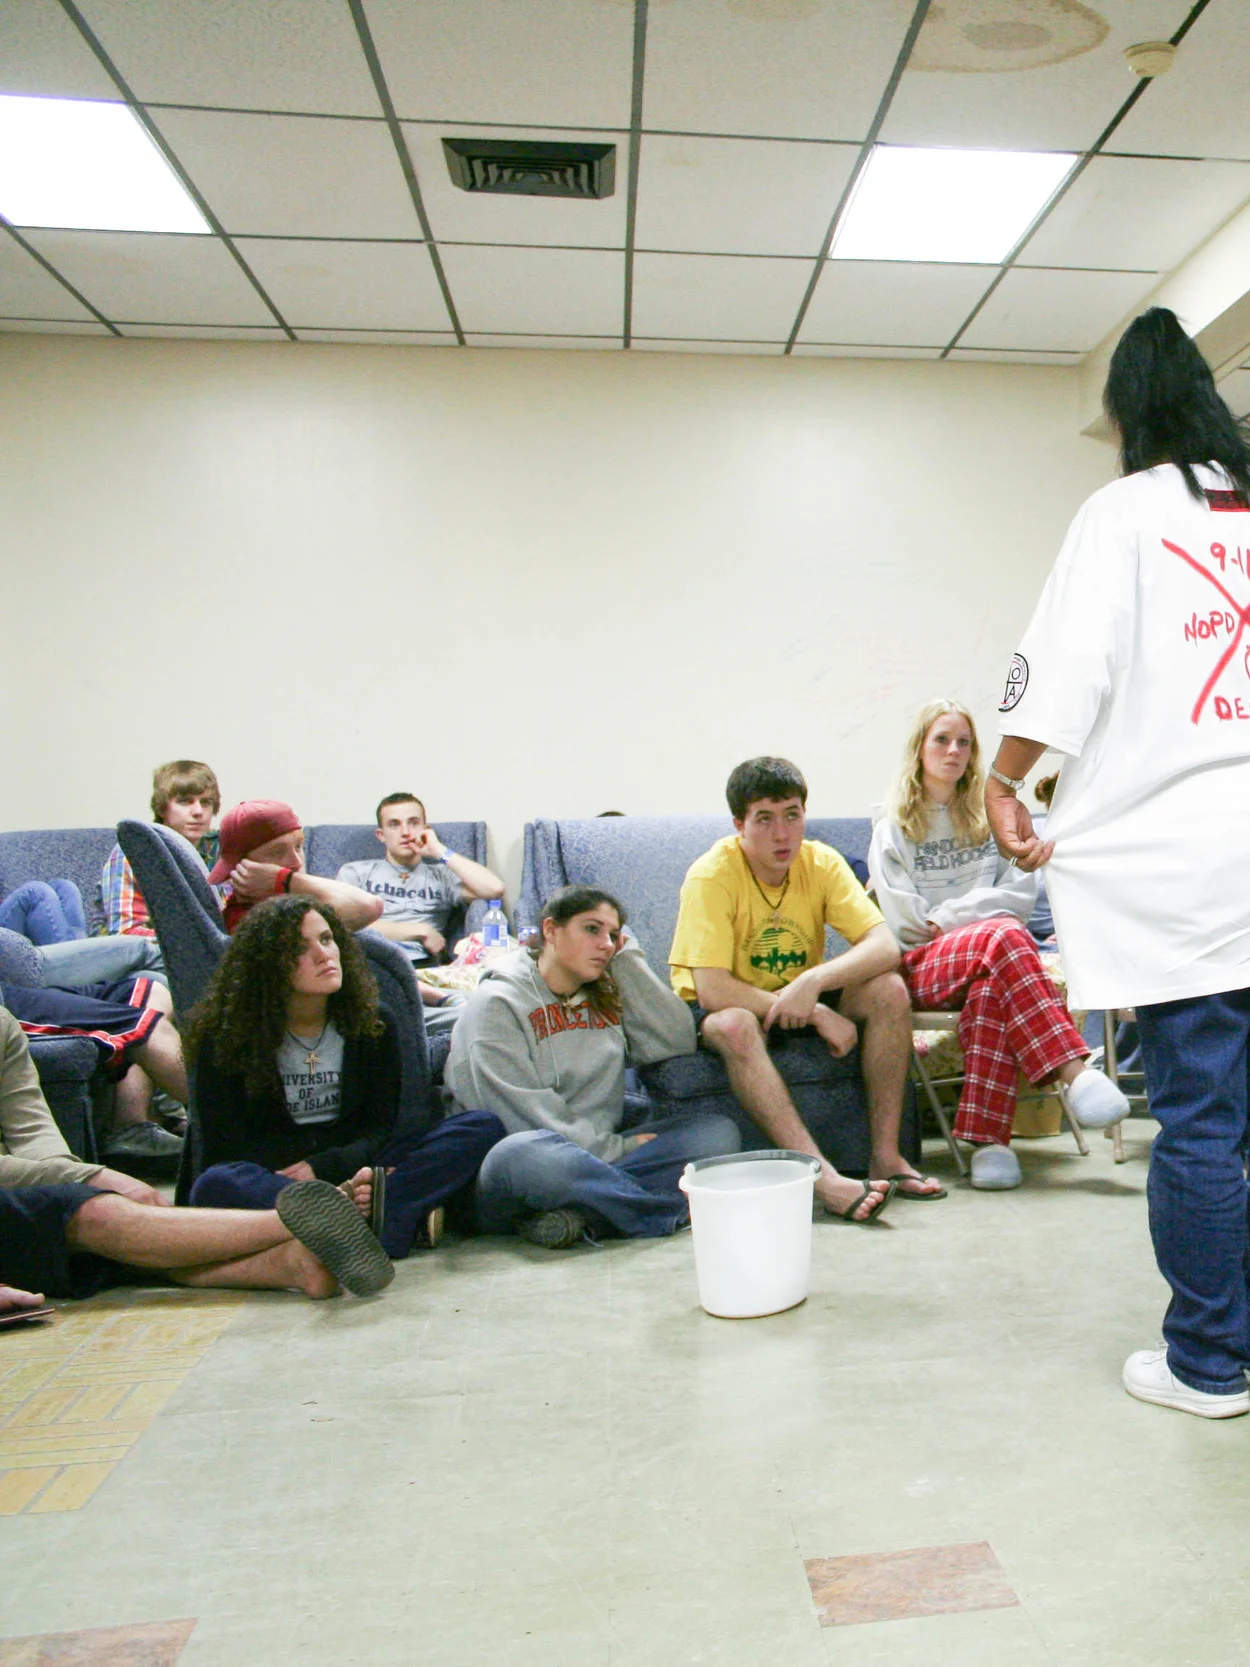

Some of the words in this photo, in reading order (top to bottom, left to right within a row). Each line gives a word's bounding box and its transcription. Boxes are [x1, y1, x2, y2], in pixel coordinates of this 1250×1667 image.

[1184, 611, 1236, 648] NOPD
[299, 1087, 314, 1100] OF
[304, 1091, 340, 1112] ISLAN
